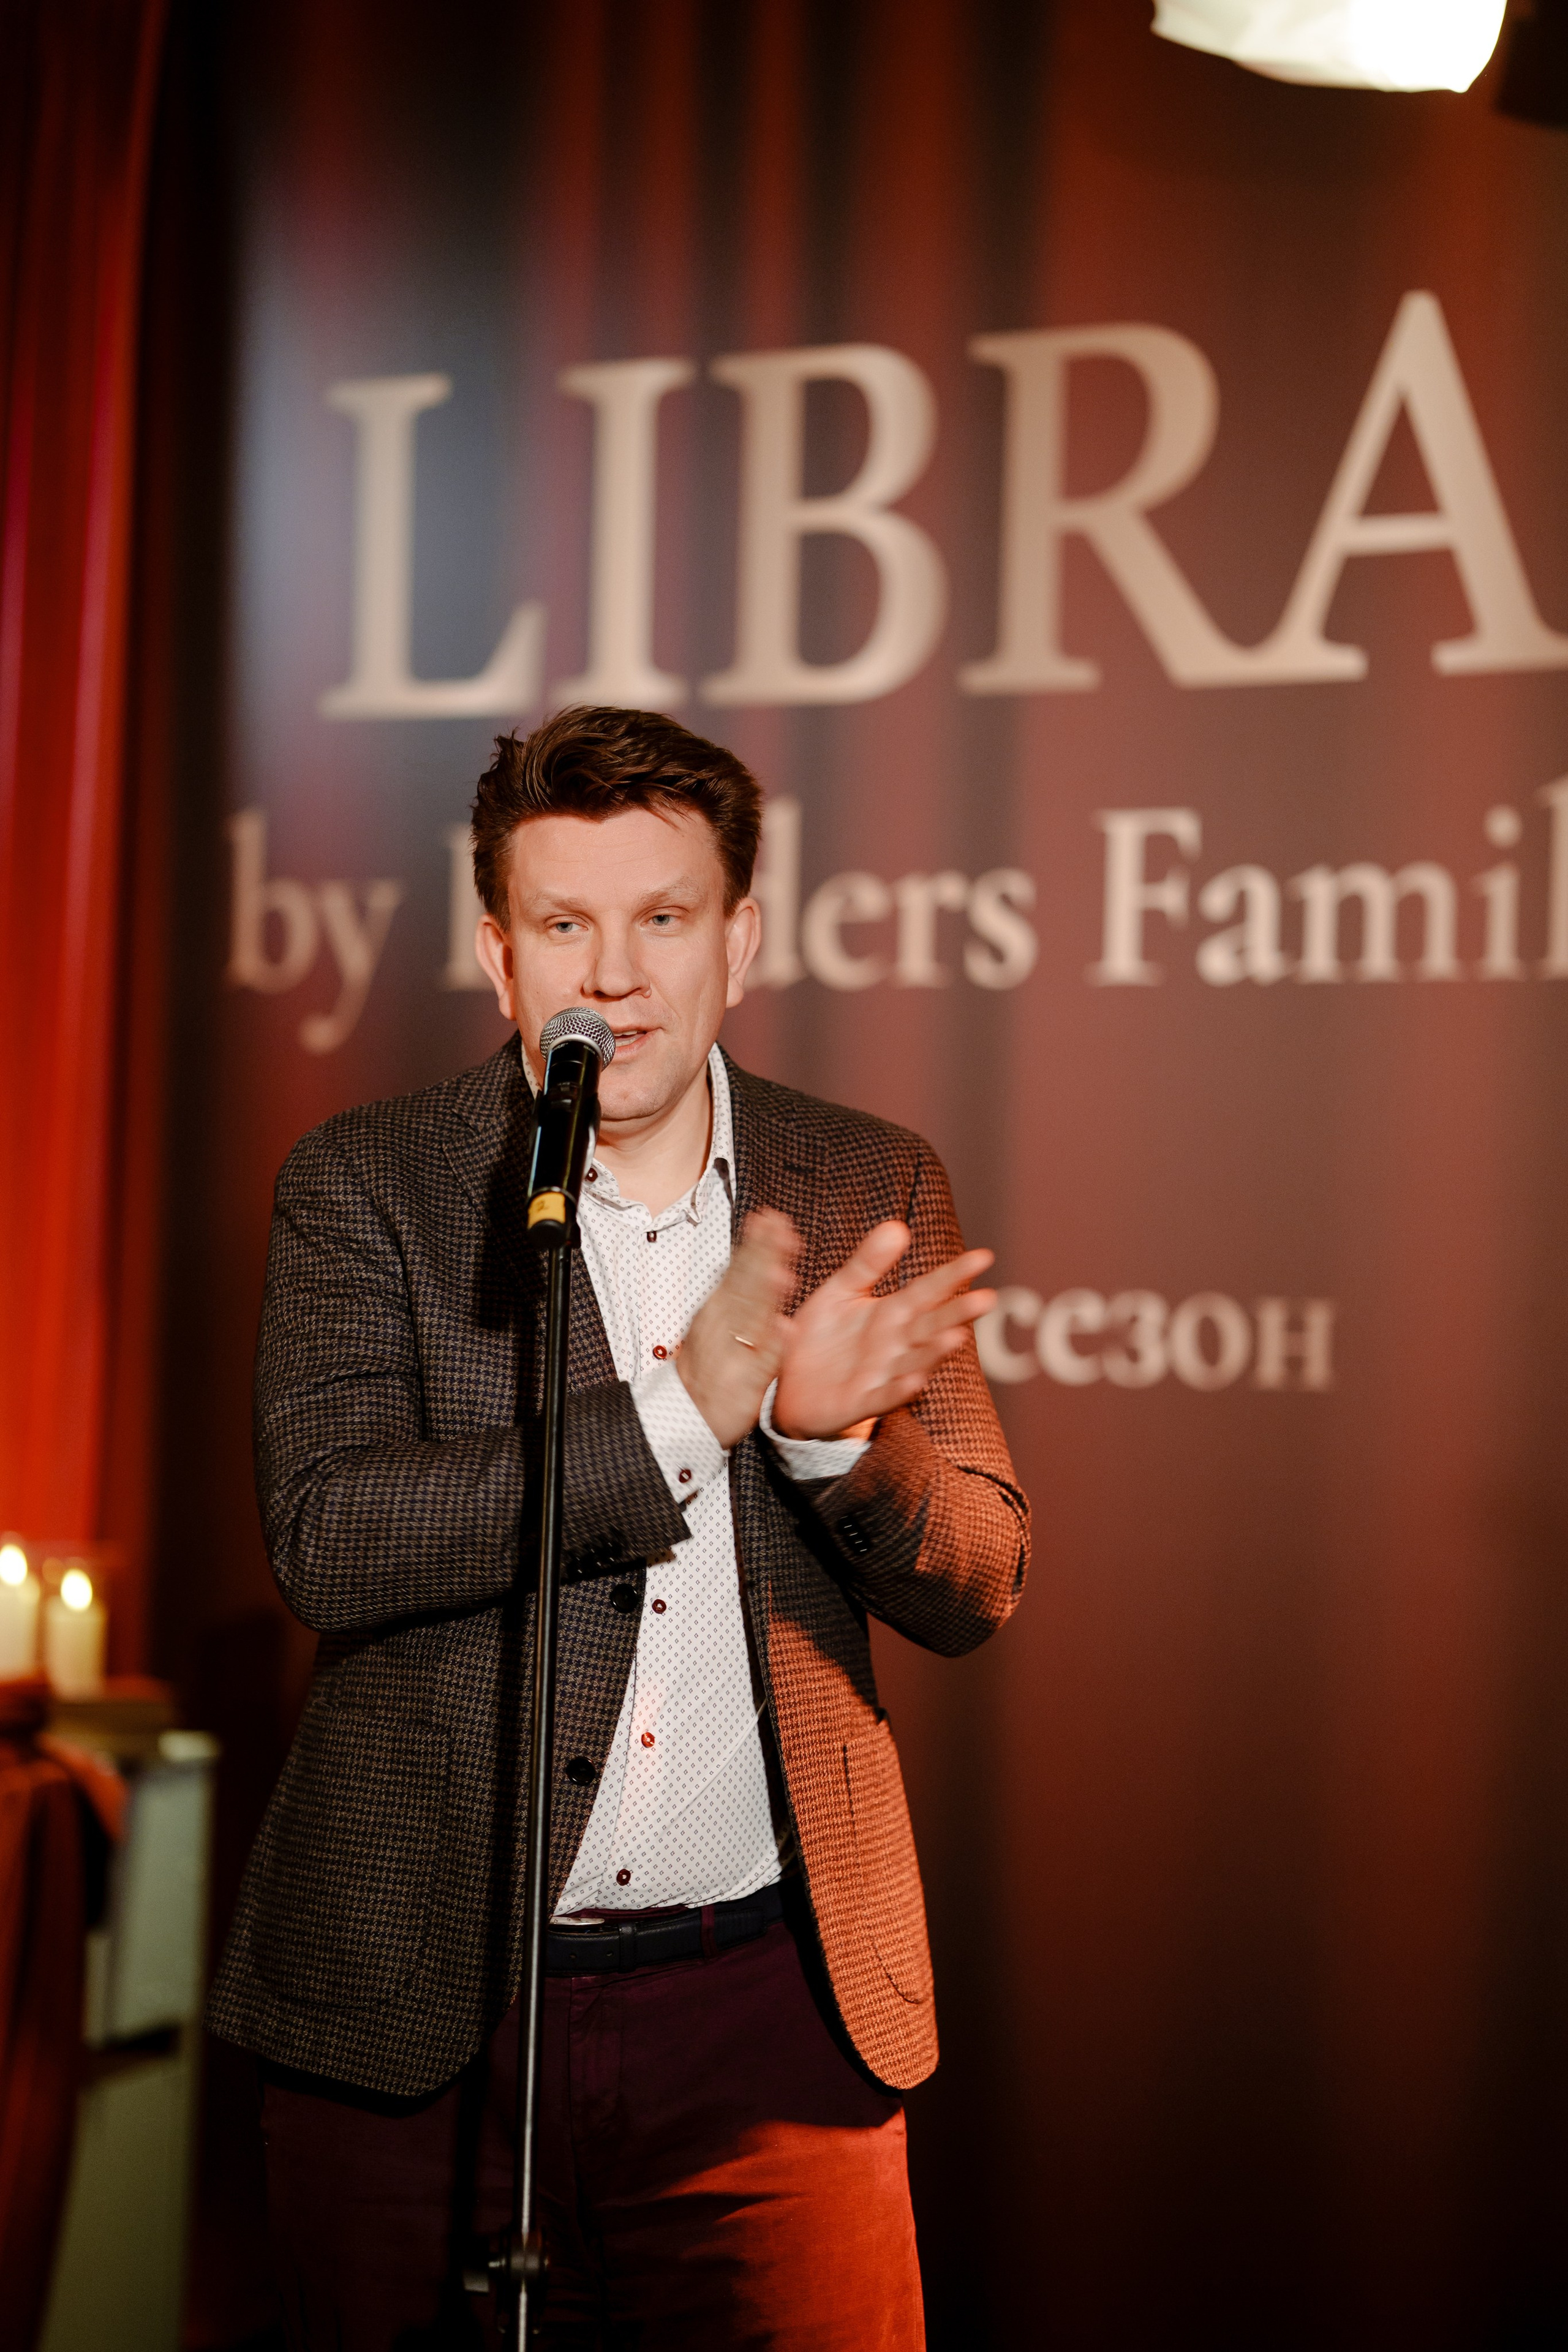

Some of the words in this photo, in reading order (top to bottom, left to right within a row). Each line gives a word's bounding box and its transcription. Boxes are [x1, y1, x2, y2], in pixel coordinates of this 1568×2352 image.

[317, 290, 1568, 722] LIBRA
[229, 809, 402, 1054] by
[975, 1286, 1338, 1392] сезон
